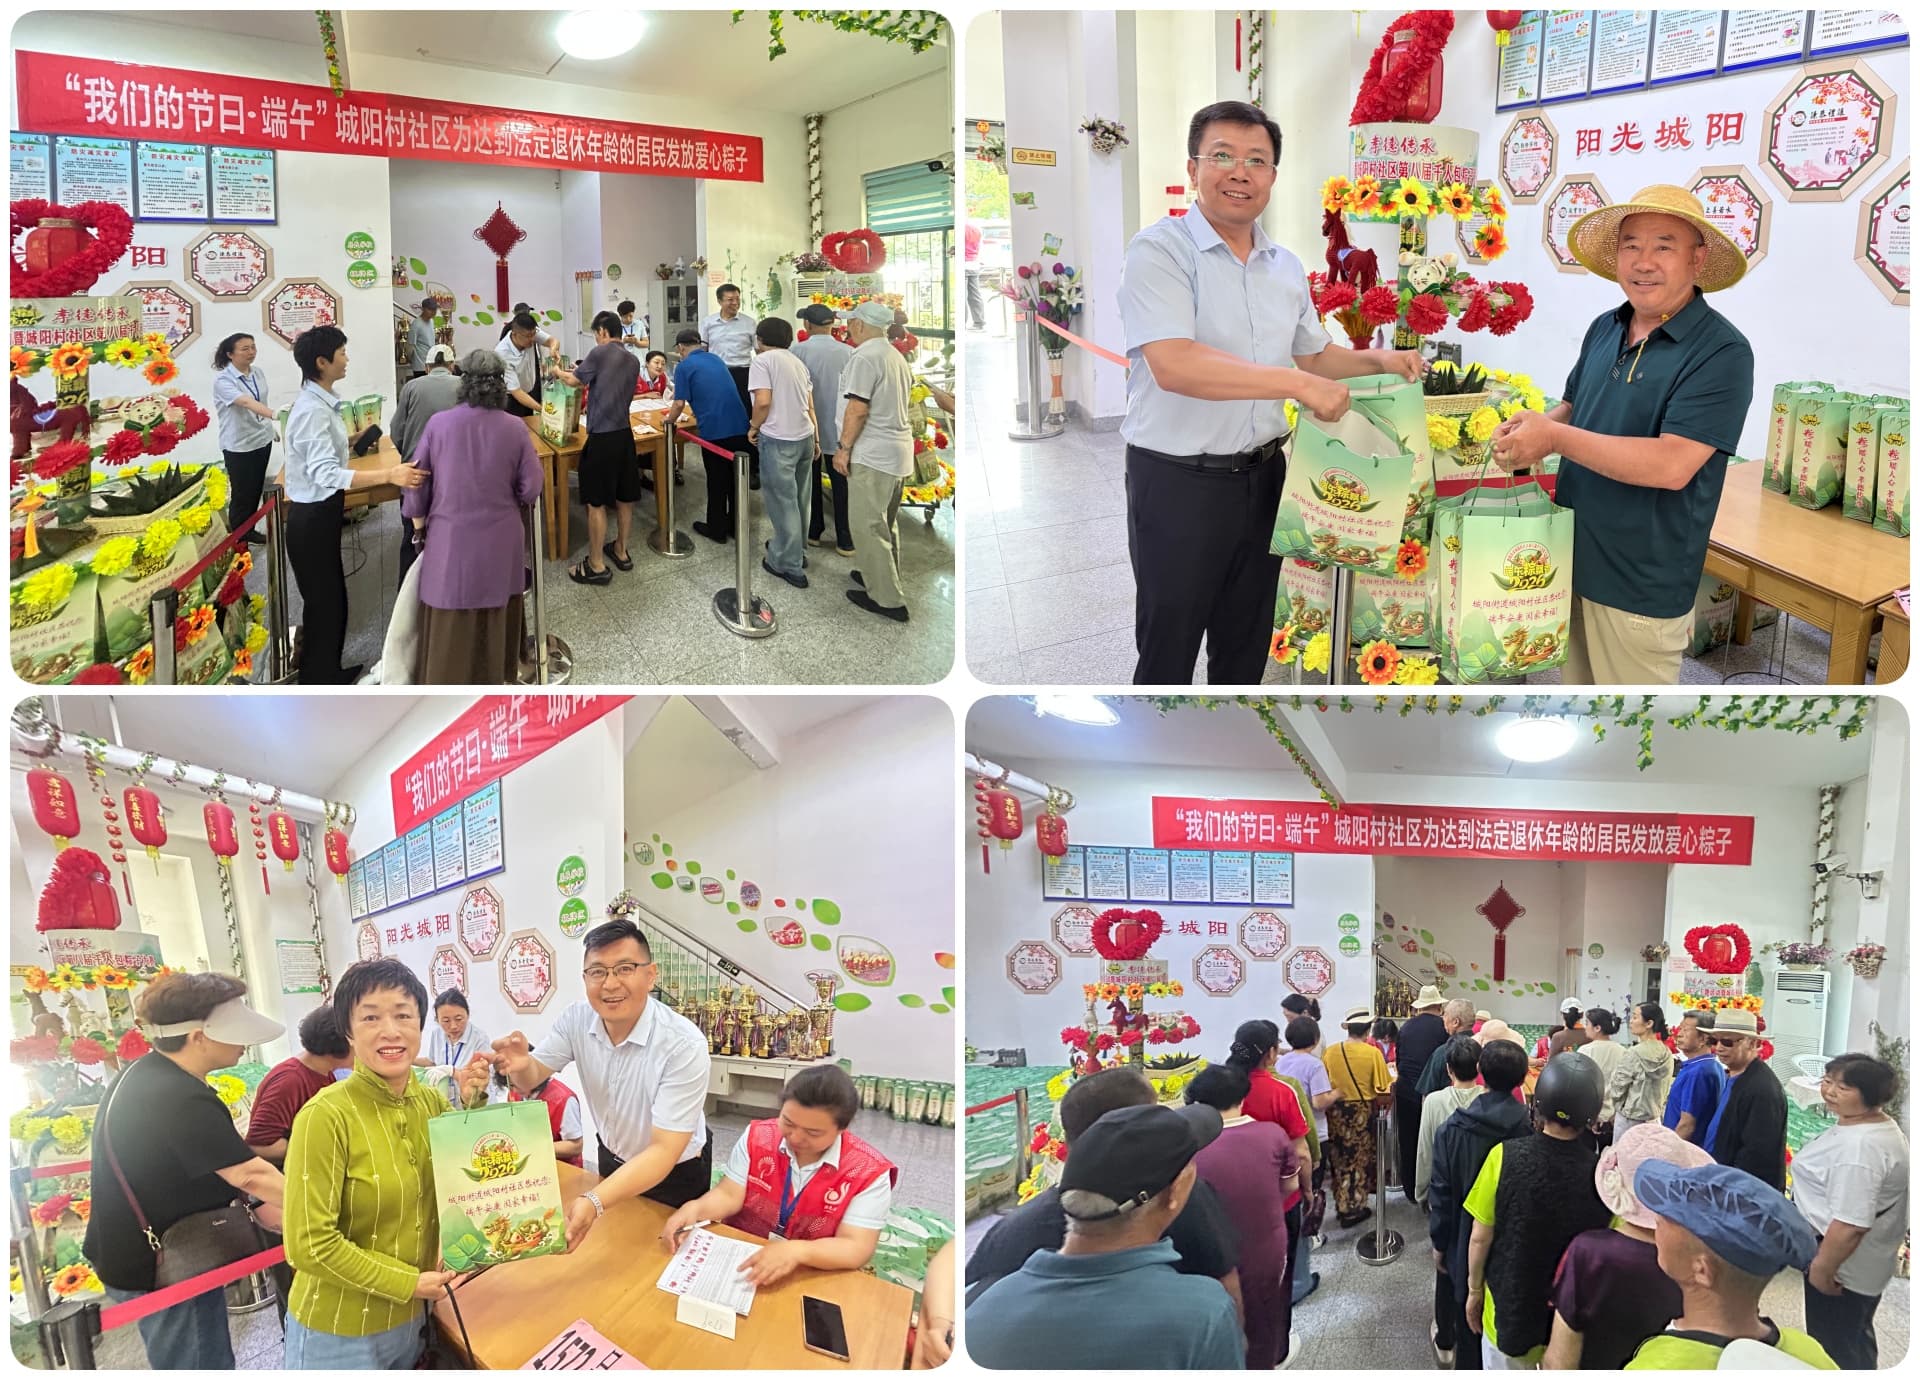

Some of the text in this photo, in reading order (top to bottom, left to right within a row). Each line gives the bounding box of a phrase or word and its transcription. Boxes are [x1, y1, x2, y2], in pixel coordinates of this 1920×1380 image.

[1576, 112, 1744, 157] 阳光城阳
[1508, 574, 1546, 593] 2026
[386, 913, 450, 944] 阳光城阳
[478, 1164, 516, 1185] 2026
